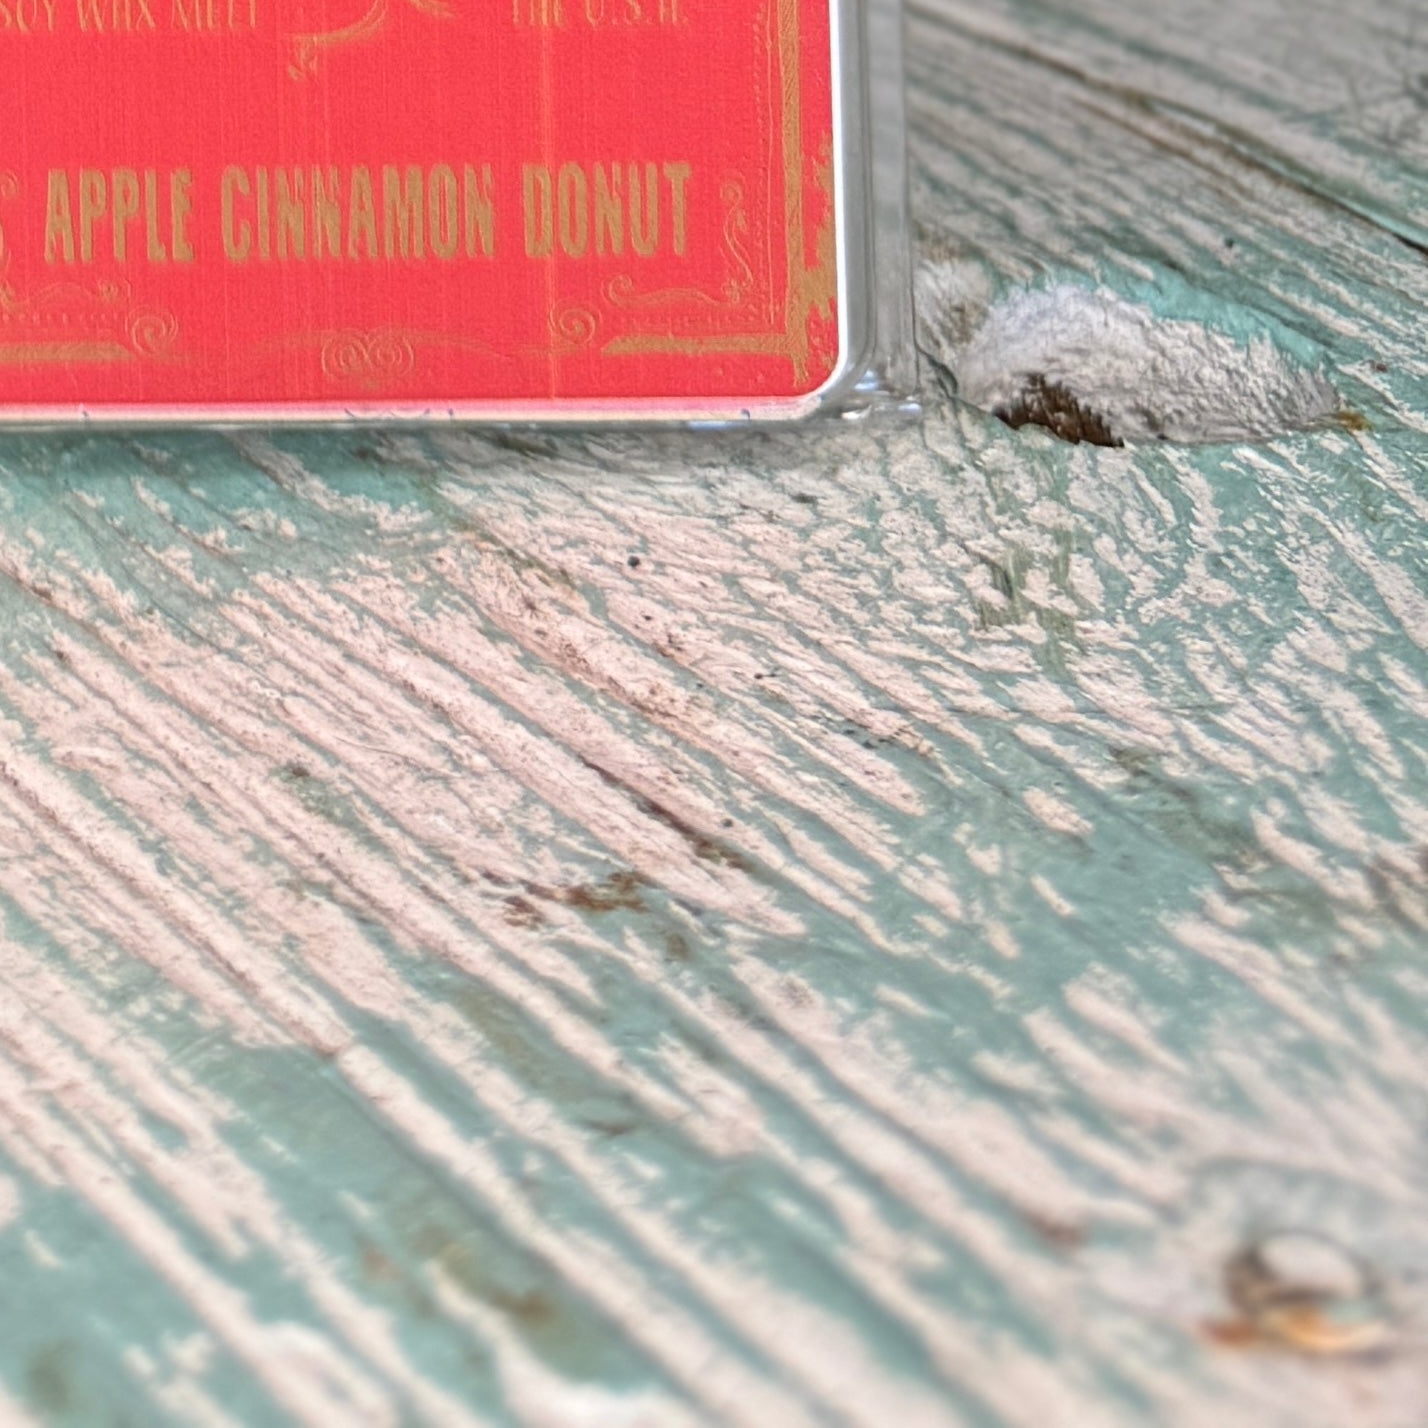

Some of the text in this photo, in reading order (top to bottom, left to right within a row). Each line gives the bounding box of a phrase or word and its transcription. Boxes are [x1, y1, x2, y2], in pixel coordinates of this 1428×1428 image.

[44, 162, 693, 263] APPLE CINNAMON DONUT
